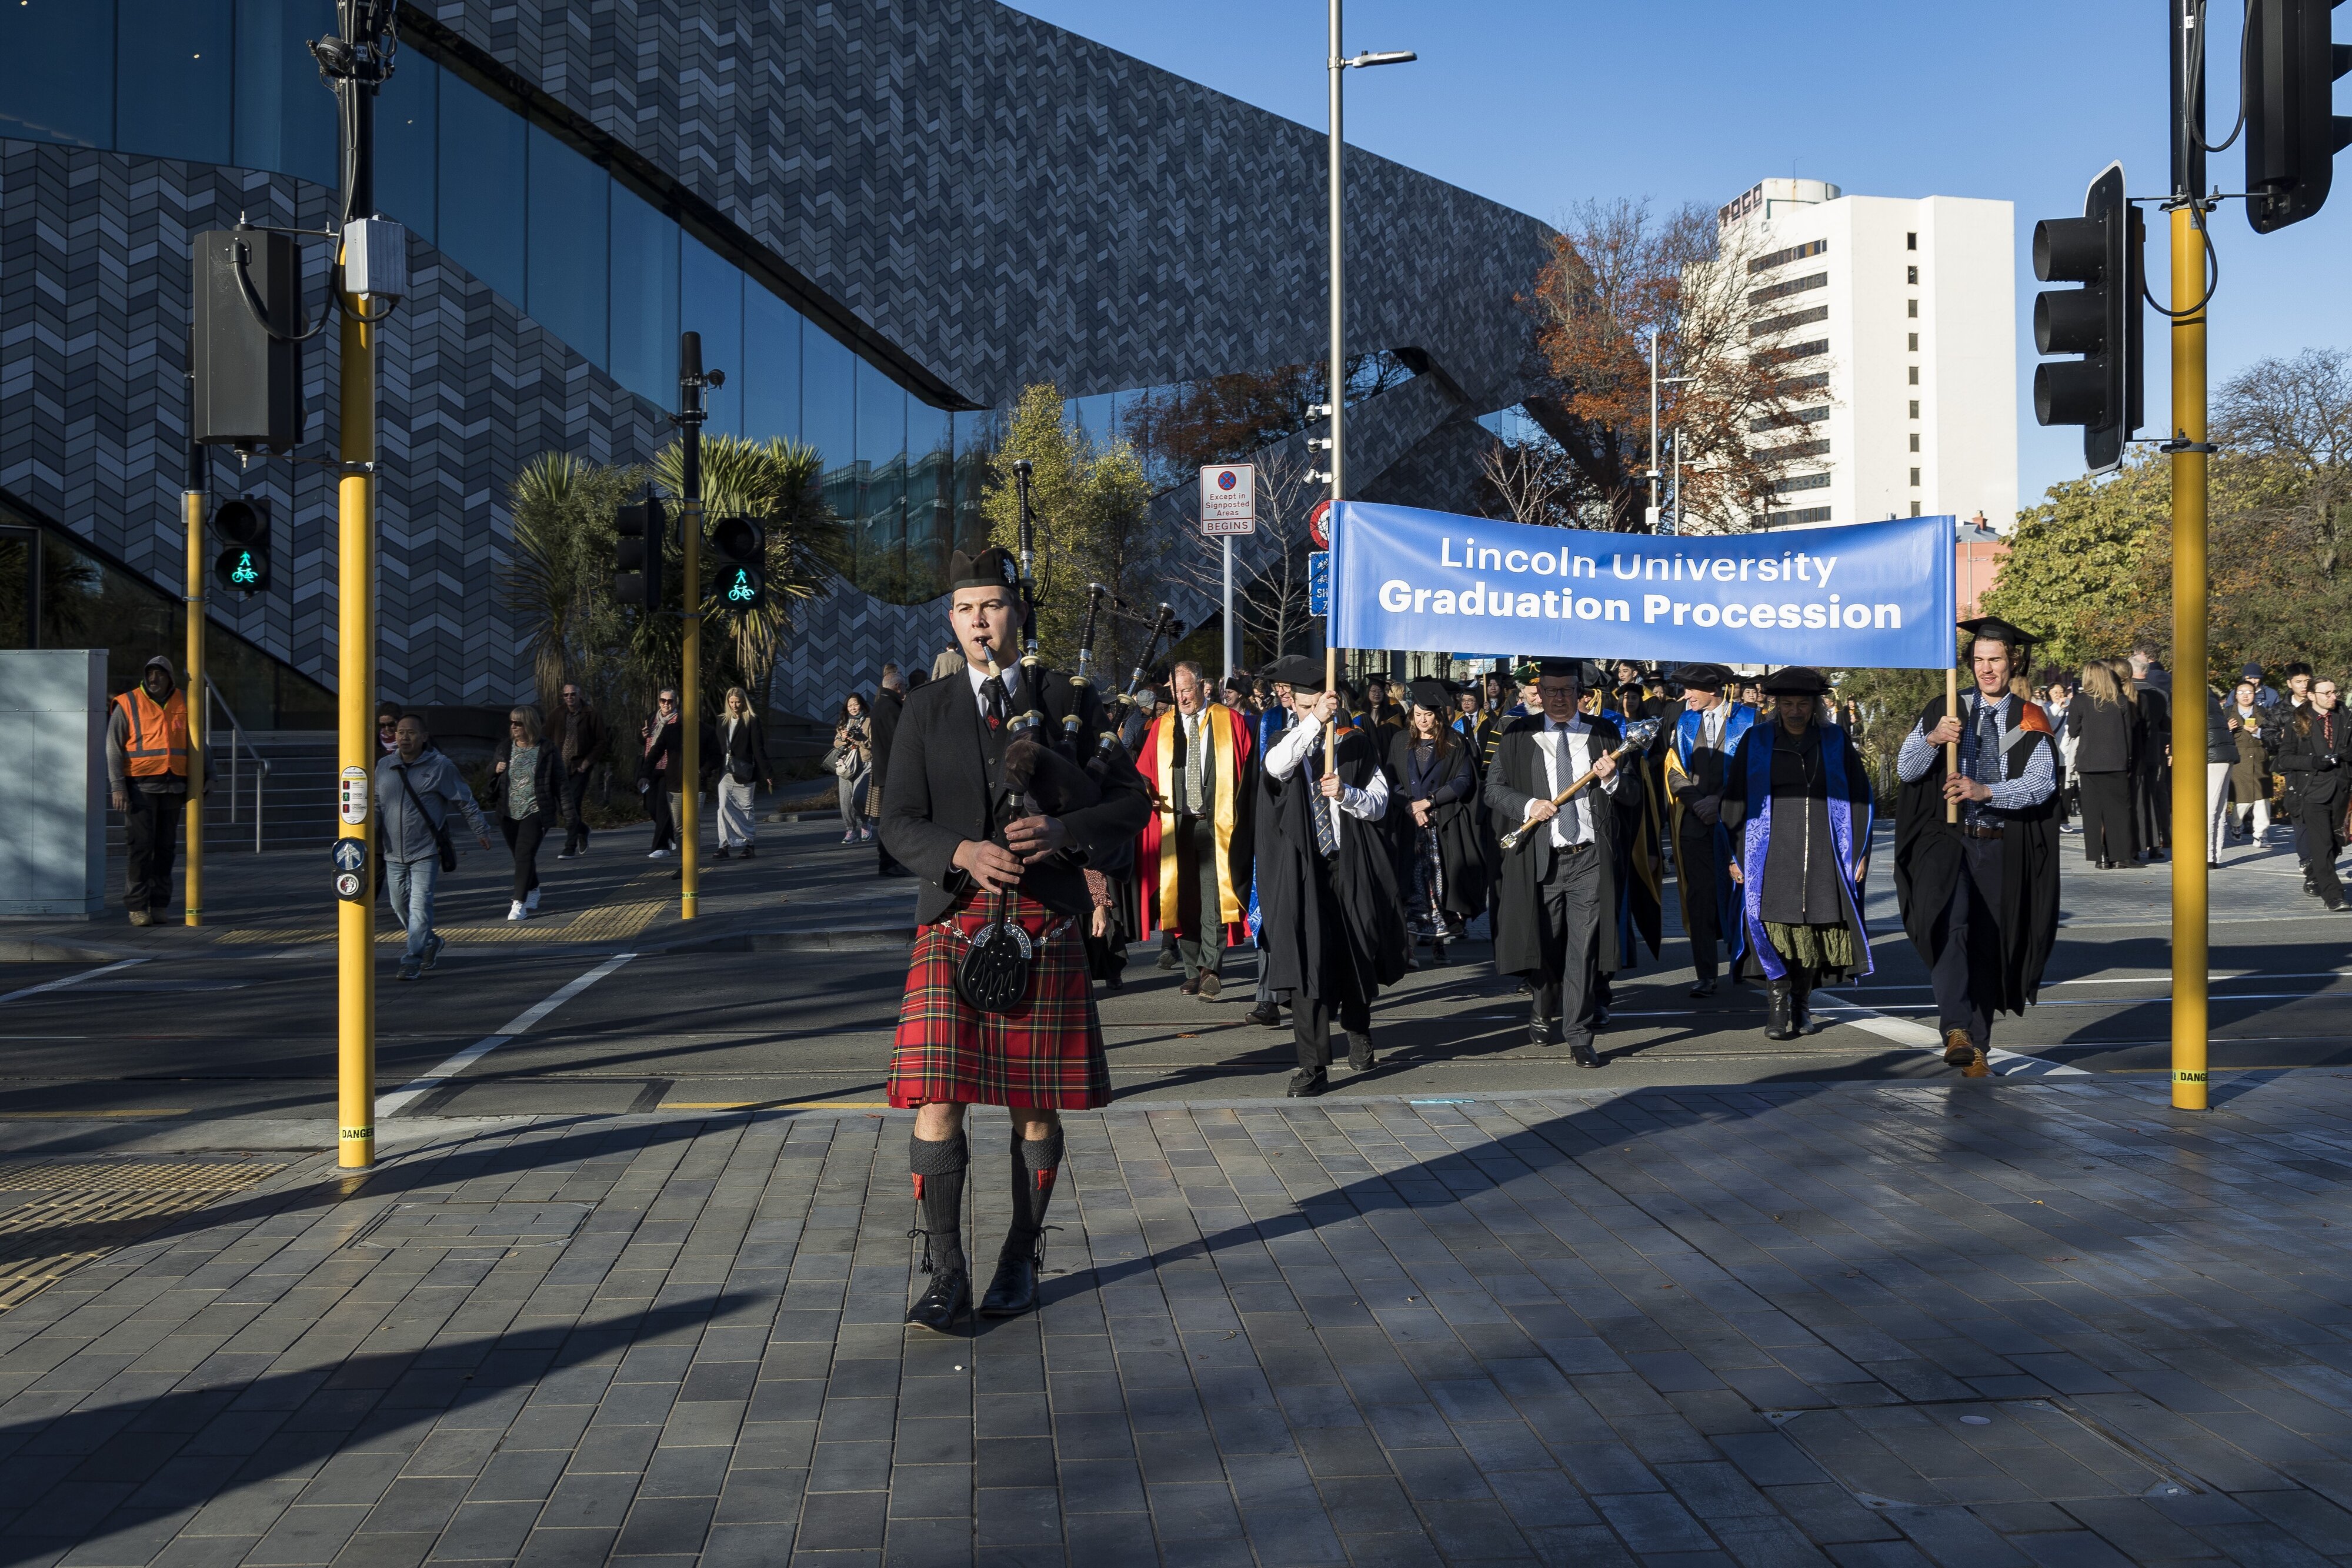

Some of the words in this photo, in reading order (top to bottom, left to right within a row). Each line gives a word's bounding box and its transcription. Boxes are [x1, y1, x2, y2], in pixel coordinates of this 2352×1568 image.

[1205, 501, 1250, 509] Signposted
[1207, 521, 1248, 531] BEGINS
[1441, 537, 1596, 578] Lincoln
[1612, 551, 1838, 589] University
[1378, 579, 1630, 622] Graduation
[1643, 593, 1902, 629] Procession
[2180, 1072, 2208, 1082] DANGE
[342, 1127, 373, 1139] DANGE
